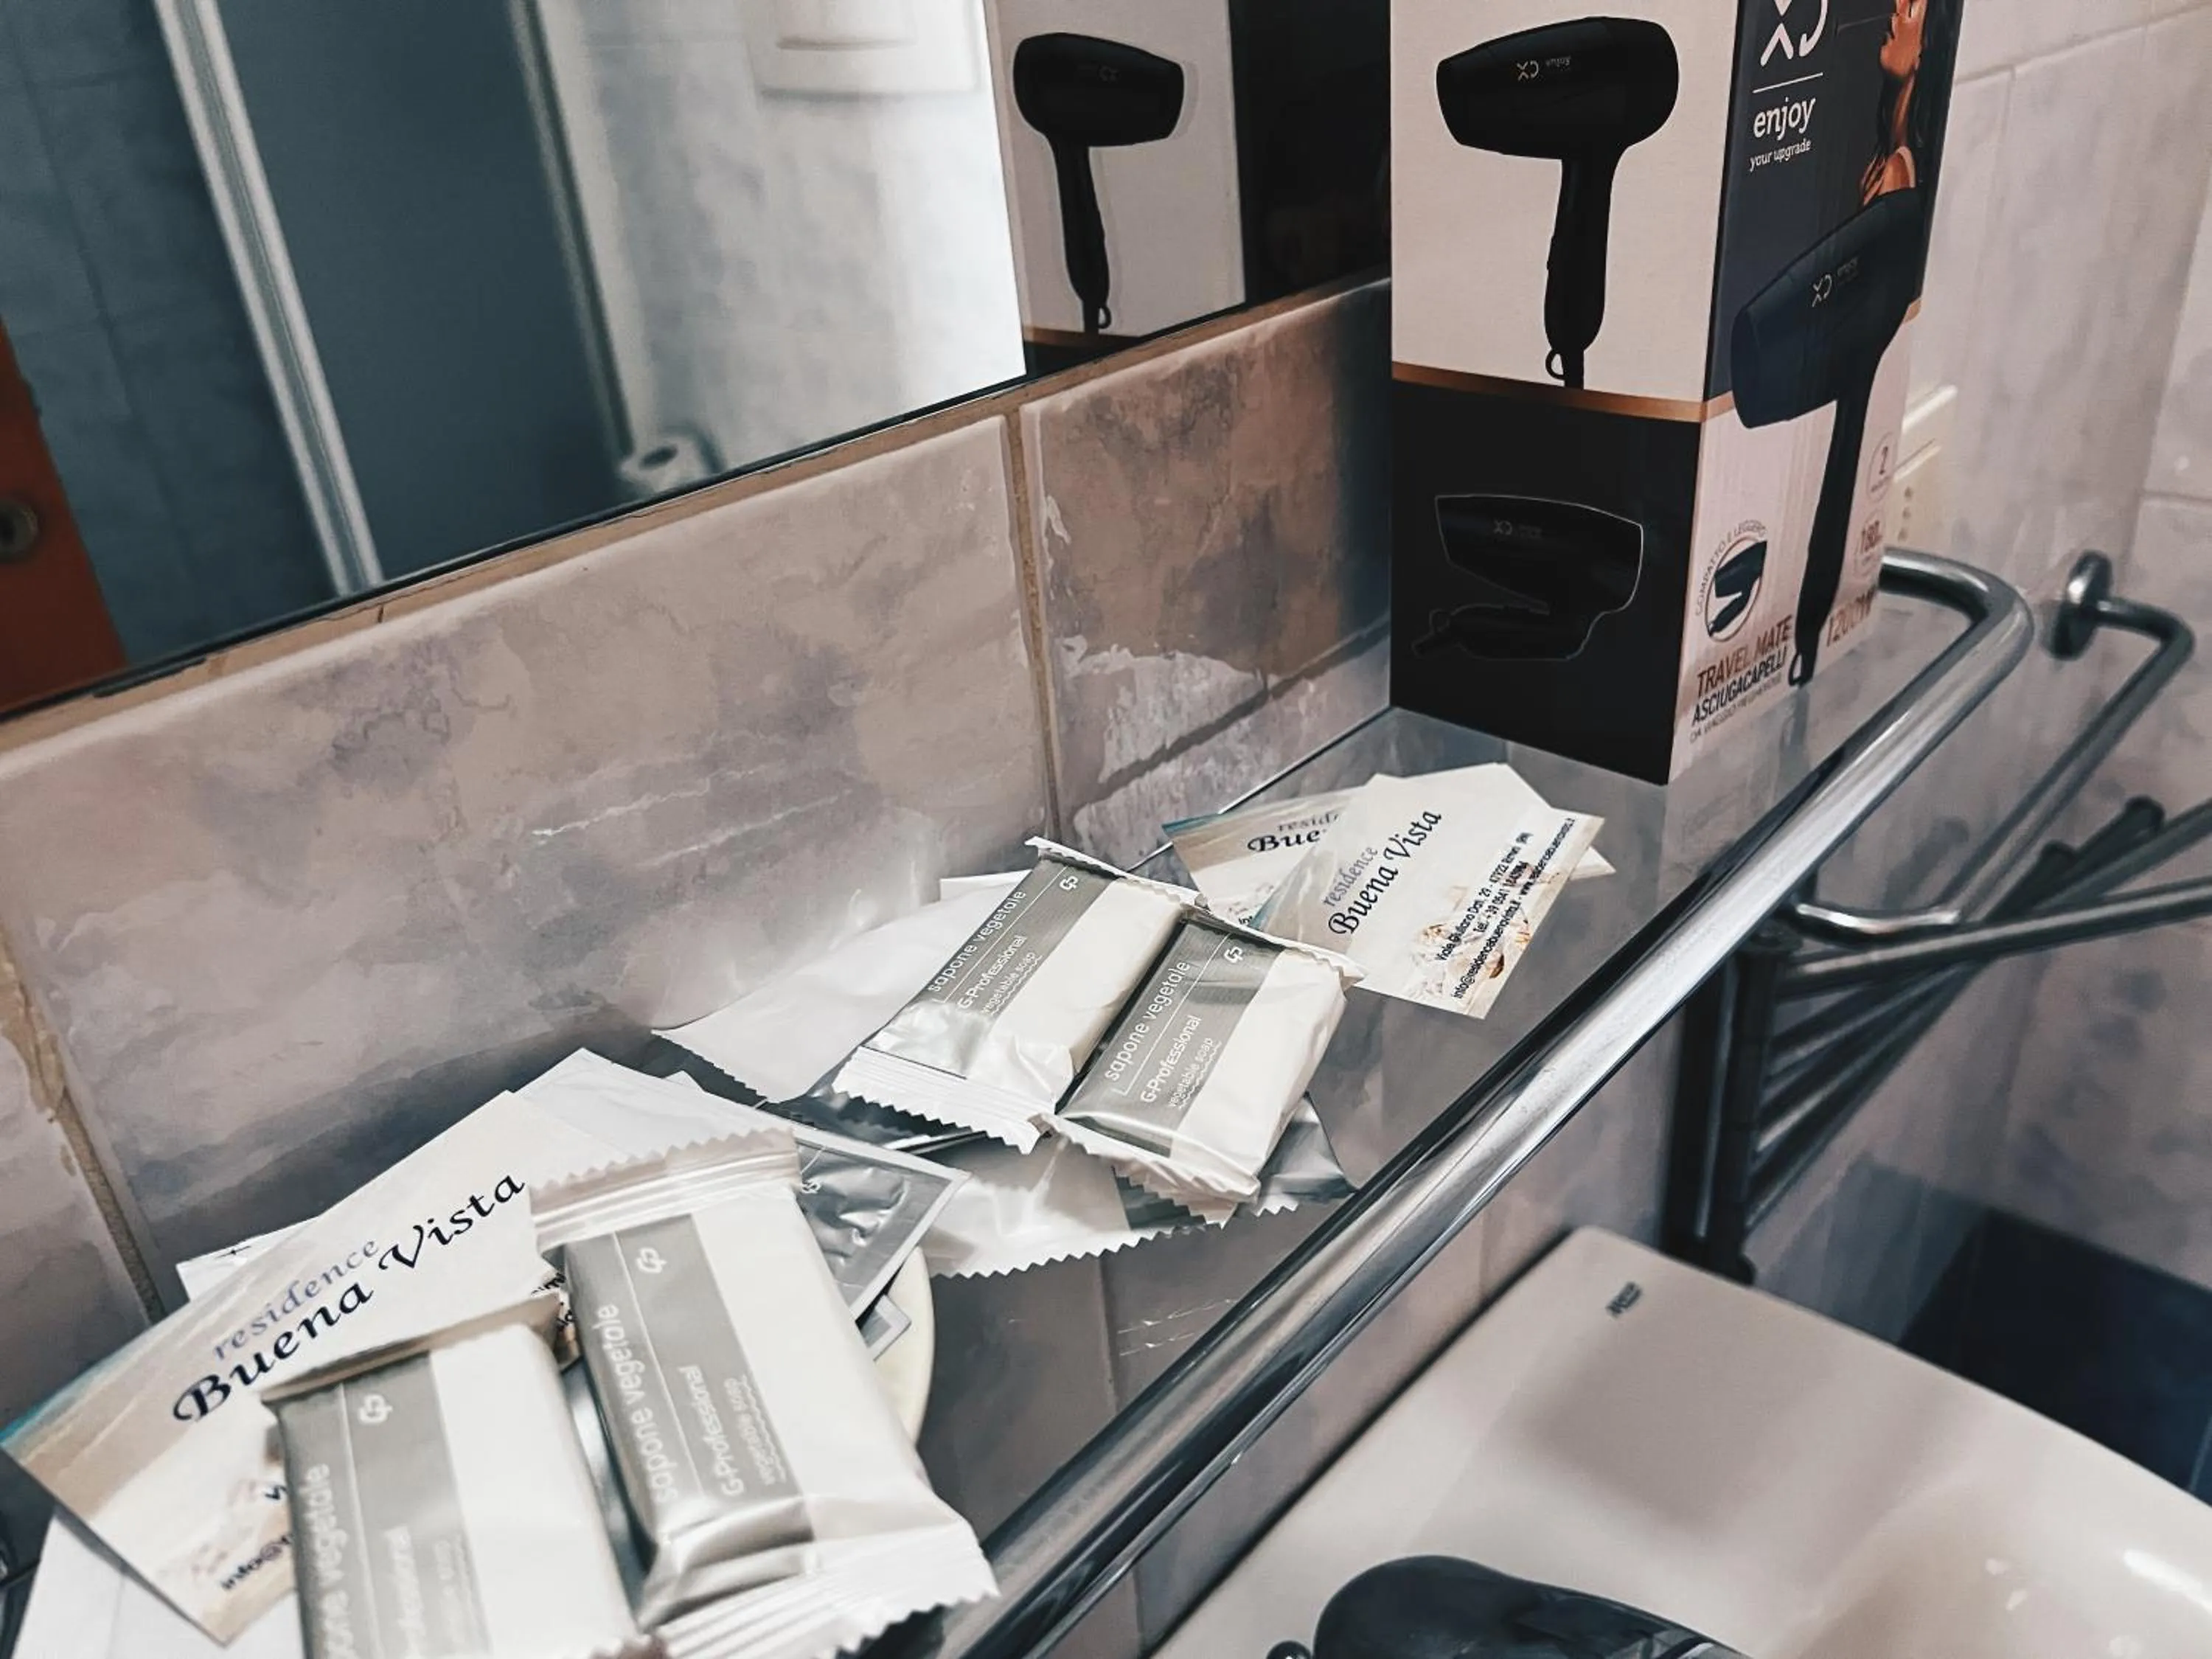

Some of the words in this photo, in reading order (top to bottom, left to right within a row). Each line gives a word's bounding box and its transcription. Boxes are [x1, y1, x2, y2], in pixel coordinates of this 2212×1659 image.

[1750, 151, 1773, 173] your
[1773, 138, 1812, 162] upgrade
[1753, 97, 1816, 140] enjoy
[1691, 646, 1787, 727] ASCIUGACAPELLI
[1697, 643, 1752, 698] TRAVEL
[1753, 615, 1792, 661] MATE
[1247, 830, 1327, 852] Bue
[1278, 813, 1339, 832] resid
[1323, 847, 1378, 907] residence
[1328, 866, 1399, 934] Buena
[1382, 810, 1441, 858] Vista
[928, 944, 978, 992] sapone
[973, 891, 1026, 942] vegetale
[1105, 1022, 1150, 1081] sapone
[1143, 961, 1191, 1020] vegetale
[171, 1280, 375, 1422] Buena
[378, 1175, 526, 1270] Vista
[214, 1239, 380, 1361] residence
[592, 1303, 646, 1405] vegetale
[630, 1407, 678, 1503] sapone
